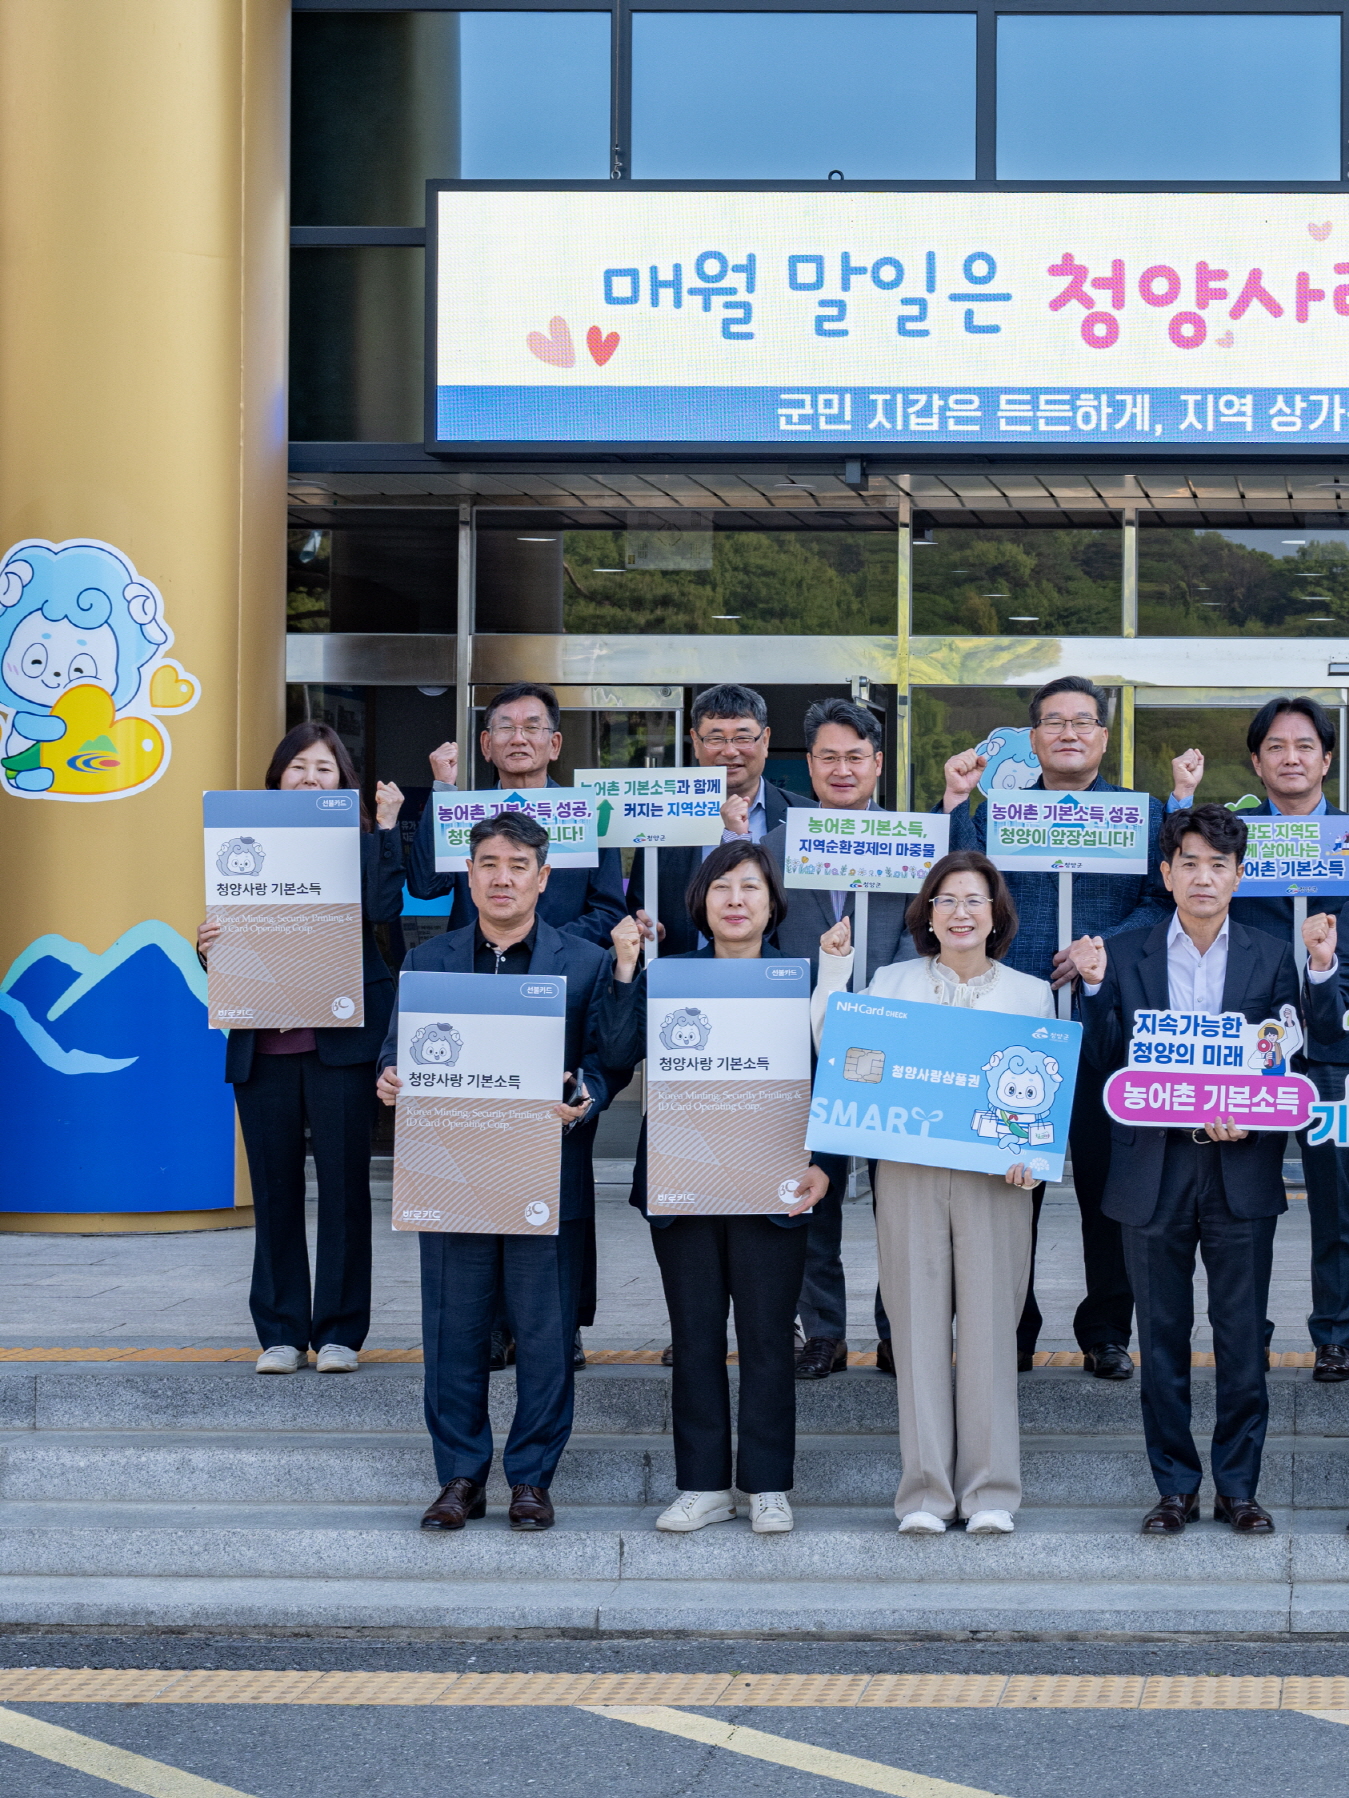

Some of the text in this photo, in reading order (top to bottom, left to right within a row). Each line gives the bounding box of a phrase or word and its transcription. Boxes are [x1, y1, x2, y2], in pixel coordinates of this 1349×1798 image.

[603, 250, 757, 340] 매월
[788, 250, 1013, 338] 말일은
[777, 393, 853, 432] 군민
[868, 393, 983, 432] 지갑은
[997, 393, 1164, 435] 든든하게,
[1179, 393, 1254, 433] 지역
[581, 778, 721, 797] 어촌 기본소득과 함께
[437, 804, 486, 822] 농어촌
[556, 800, 592, 819] 성공,
[624, 801, 721, 818] 커지는 지역상권
[991, 803, 1144, 825] 농어촌 기본소득 성공,
[808, 816, 928, 838] 농어촌 기본소득,
[1247, 823, 1319, 840] 람도 지역도
[1000, 827, 1136, 848] 청양이 앞장섭니다!
[799, 838, 936, 858] 지역순환경제의 마중물
[1261, 842, 1321, 859] 살아나는
[1244, 860, 1345, 878] 어촌 기본소득
[216, 882, 322, 897] 청양사랑 기본소득
[218, 924, 228, 933] D
[885, 1010, 908, 1020] CHECK
[1136, 1013, 1243, 1039] 지속가능한
[659, 1056, 770, 1072] 청양사랑 기본소득
[1132, 1041, 1244, 1067] 청양의 미래
[408, 1072, 522, 1090] 청양사랑 기본소득
[891, 1064, 981, 1088] 청양사랑상품권
[1123, 1081, 1300, 1116] 농어촌 기본소득
